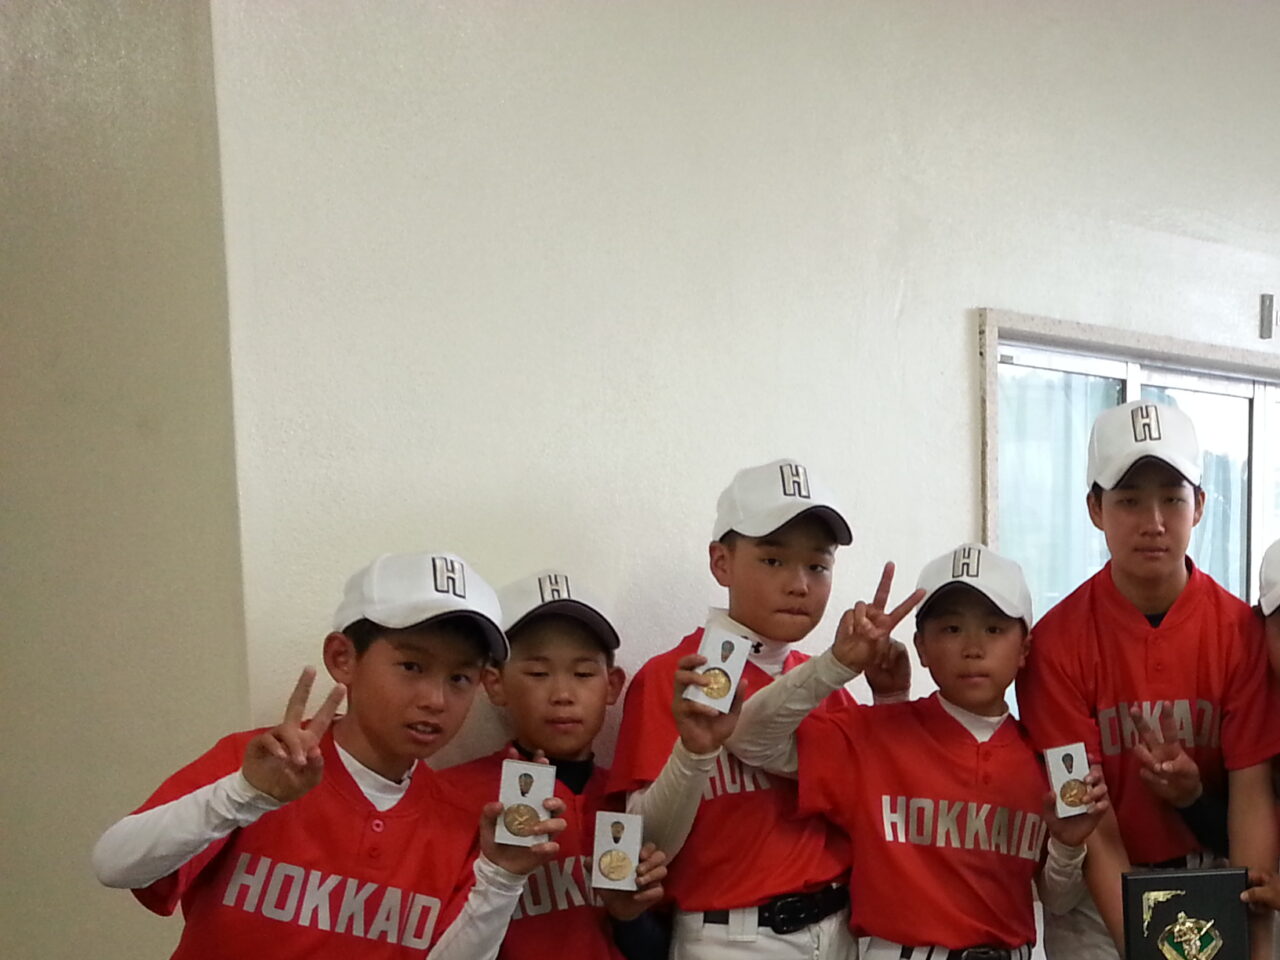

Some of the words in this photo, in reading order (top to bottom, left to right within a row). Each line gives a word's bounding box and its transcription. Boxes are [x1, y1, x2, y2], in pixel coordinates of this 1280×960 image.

[1131, 404, 1162, 443] H
[780, 463, 811, 499] H
[432, 557, 466, 599] H
[952, 547, 981, 578] H
[538, 574, 571, 603] H
[222, 852, 442, 950] HOKKAD
